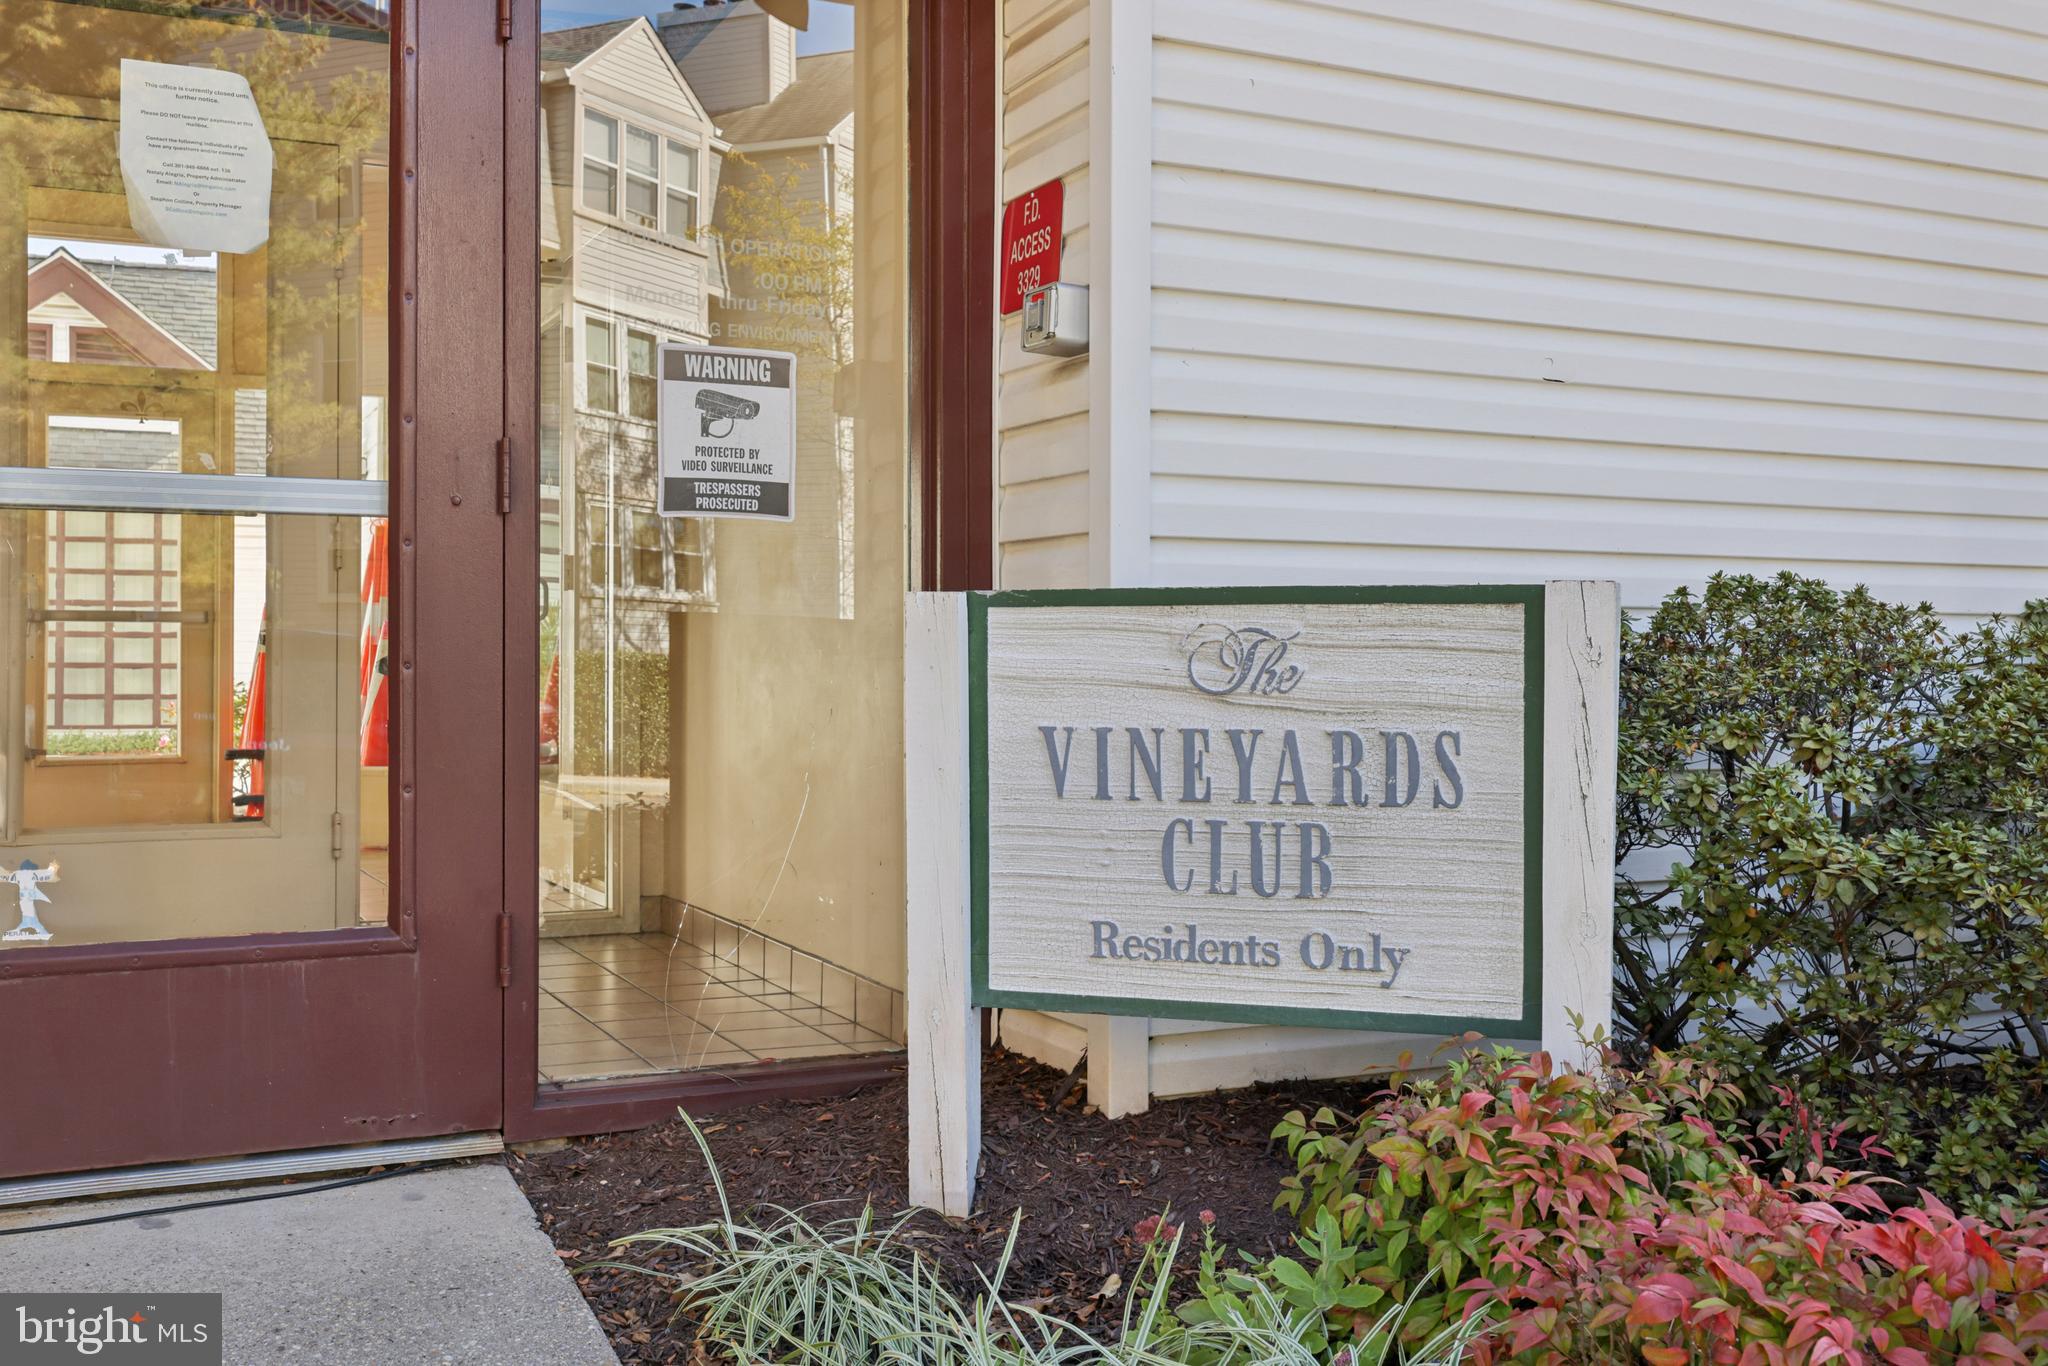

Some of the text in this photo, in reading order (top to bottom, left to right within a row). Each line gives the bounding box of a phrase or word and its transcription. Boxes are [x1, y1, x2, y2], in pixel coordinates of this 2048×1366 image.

[184, 87, 213, 96] currently
[1024, 198, 1041, 226] F.D.
[1010, 226, 1051, 264] ACCESS
[793, 275, 822, 293] PM
[1017, 265, 1041, 295] 3329
[719, 296, 758, 311] thru
[767, 297, 827, 320] Friday
[684, 354, 771, 383] WARNING
[695, 445, 760, 460] PROTECTED BY
[681, 460, 773, 475] VIDEO SURVEILLANCE
[694, 482, 761, 497] TRESPASSERS
[696, 497, 759, 511] PROSECUTED
[1182, 623, 1306, 696] The
[1038, 725, 1465, 809] VINEYARDS
[1161, 817, 1333, 899] CLUB
[1089, 920, 1411, 989] Residents Only
